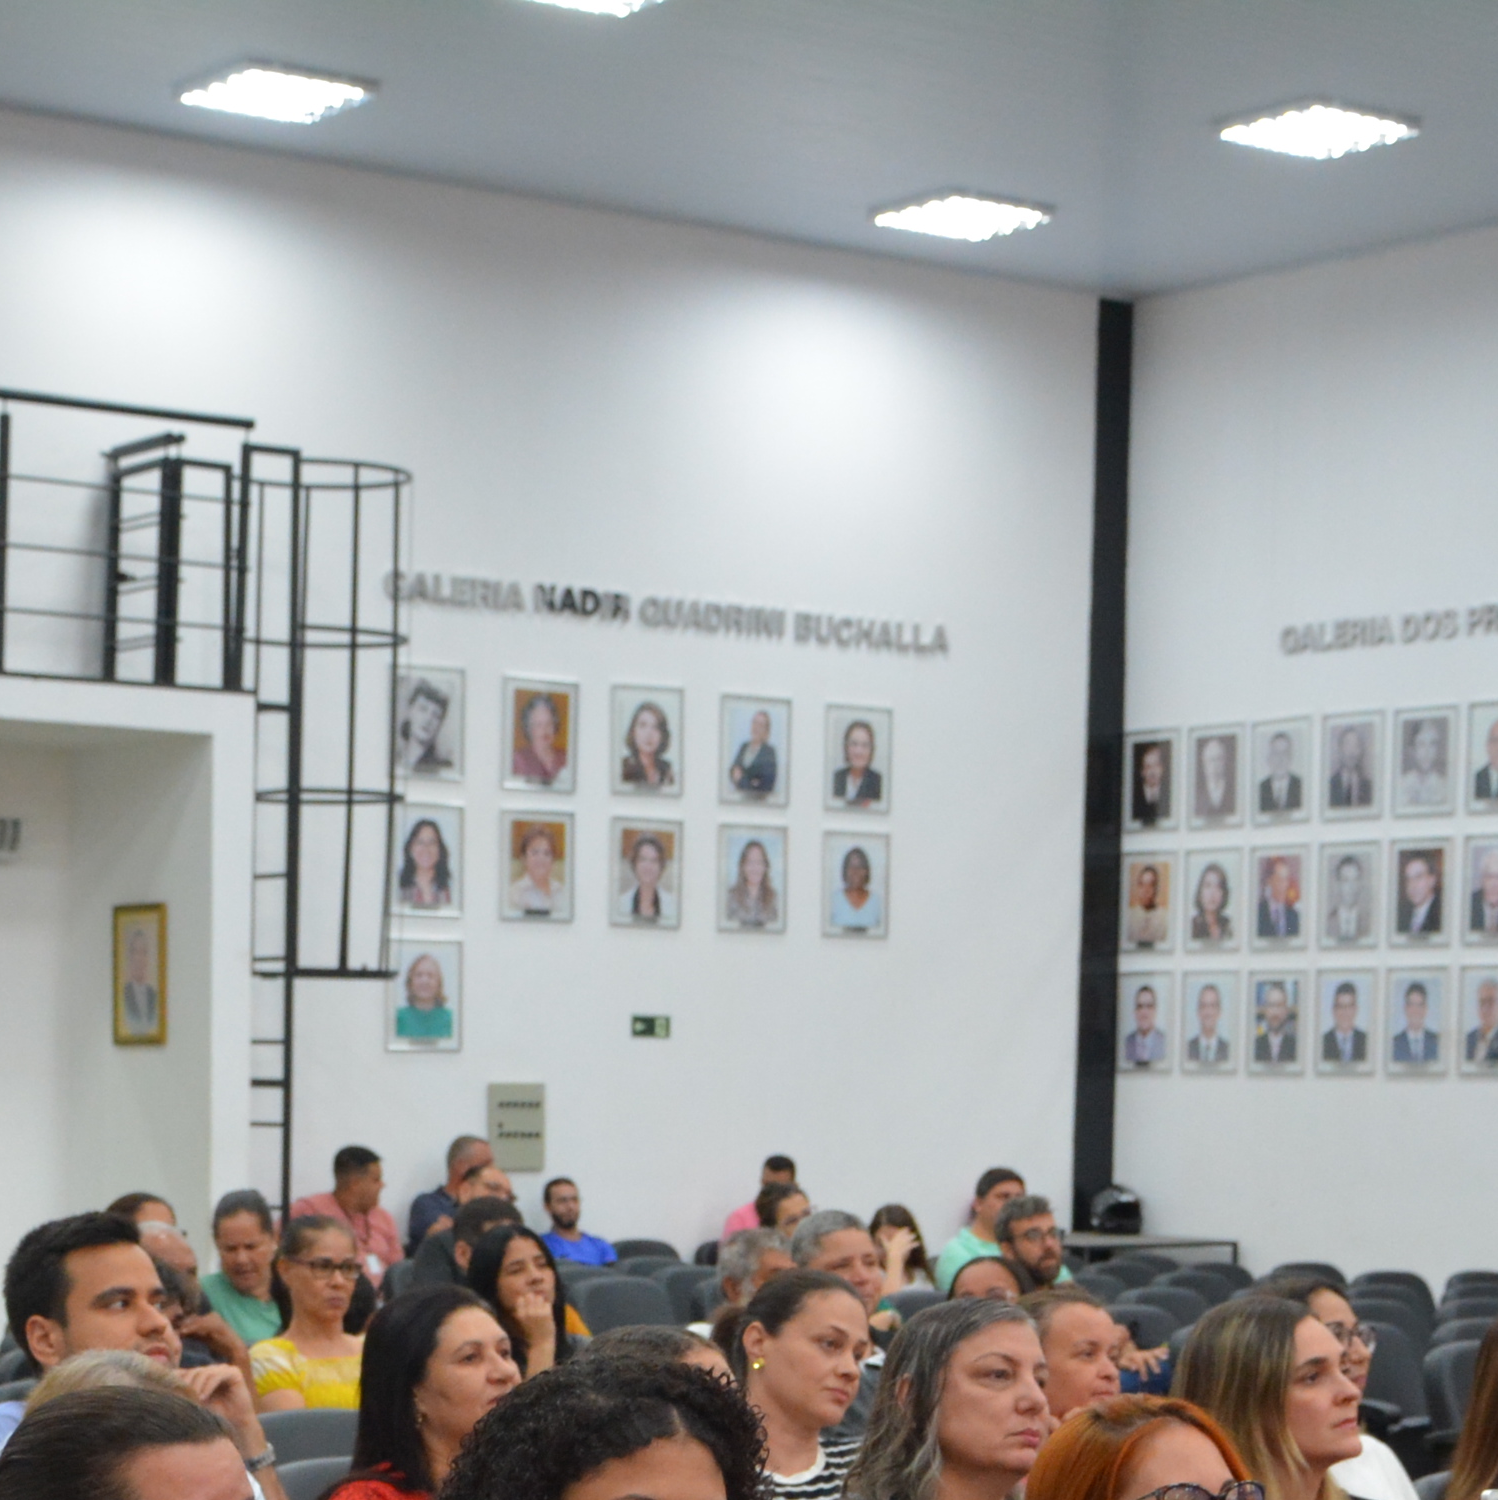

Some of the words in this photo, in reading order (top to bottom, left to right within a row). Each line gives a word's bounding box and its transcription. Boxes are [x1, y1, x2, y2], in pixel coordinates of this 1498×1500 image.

[383, 568, 527, 613] GALERIA
[533, 582, 631, 623] NADIR
[638, 596, 788, 641] QUADRINI
[794, 610, 950, 656] BUCHALLA
[1280, 615, 1396, 656] GALERIA
[1401, 608, 1460, 645] DOS
